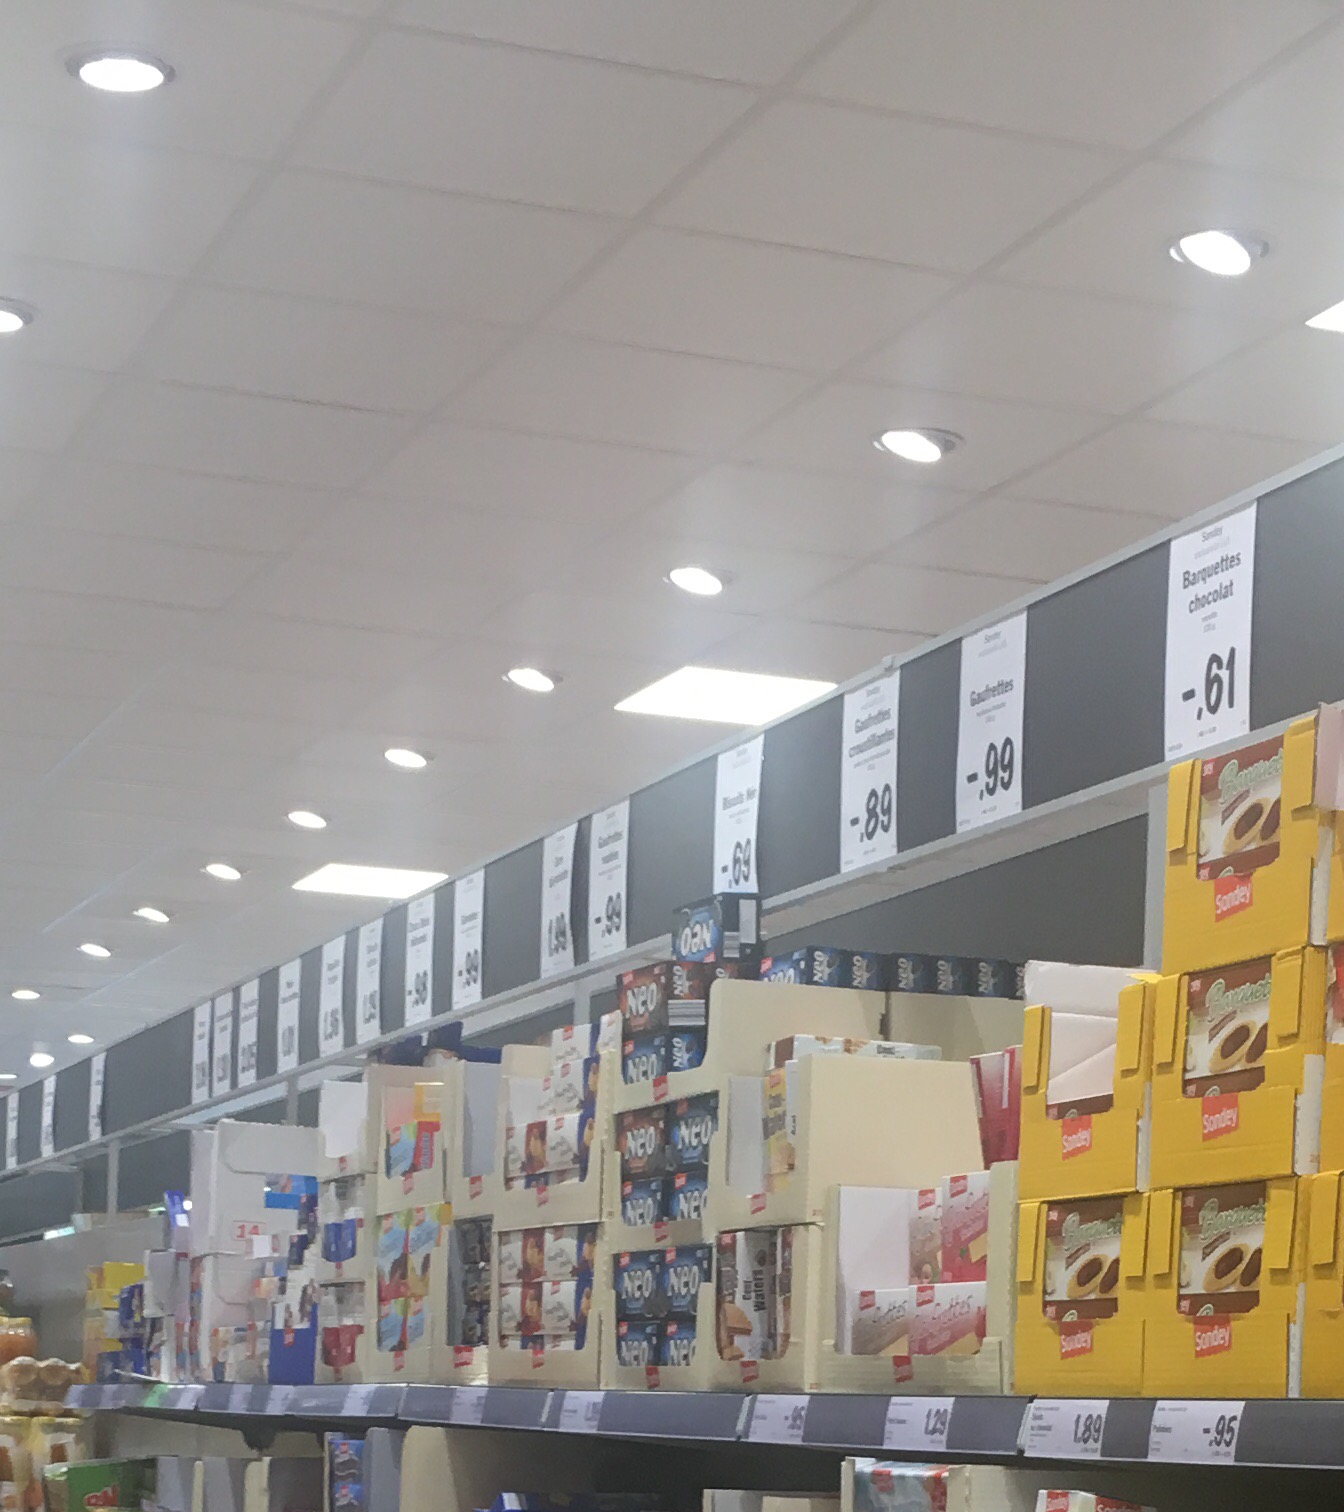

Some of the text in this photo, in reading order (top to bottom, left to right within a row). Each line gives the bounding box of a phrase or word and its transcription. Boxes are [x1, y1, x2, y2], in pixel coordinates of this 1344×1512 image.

[1182, 551, 1243, 590] Barquettes
[1187, 578, 1235, 615] chocolat
[1181, 646, 1237, 721] -.61
[966, 735, 1015, 802] -.99
[849, 782, 893, 844] -.89
[1215, 883, 1251, 914] Sondey
[1203, 1105, 1238, 1134] Sondey
[1195, 1324, 1231, 1351] Sondey
